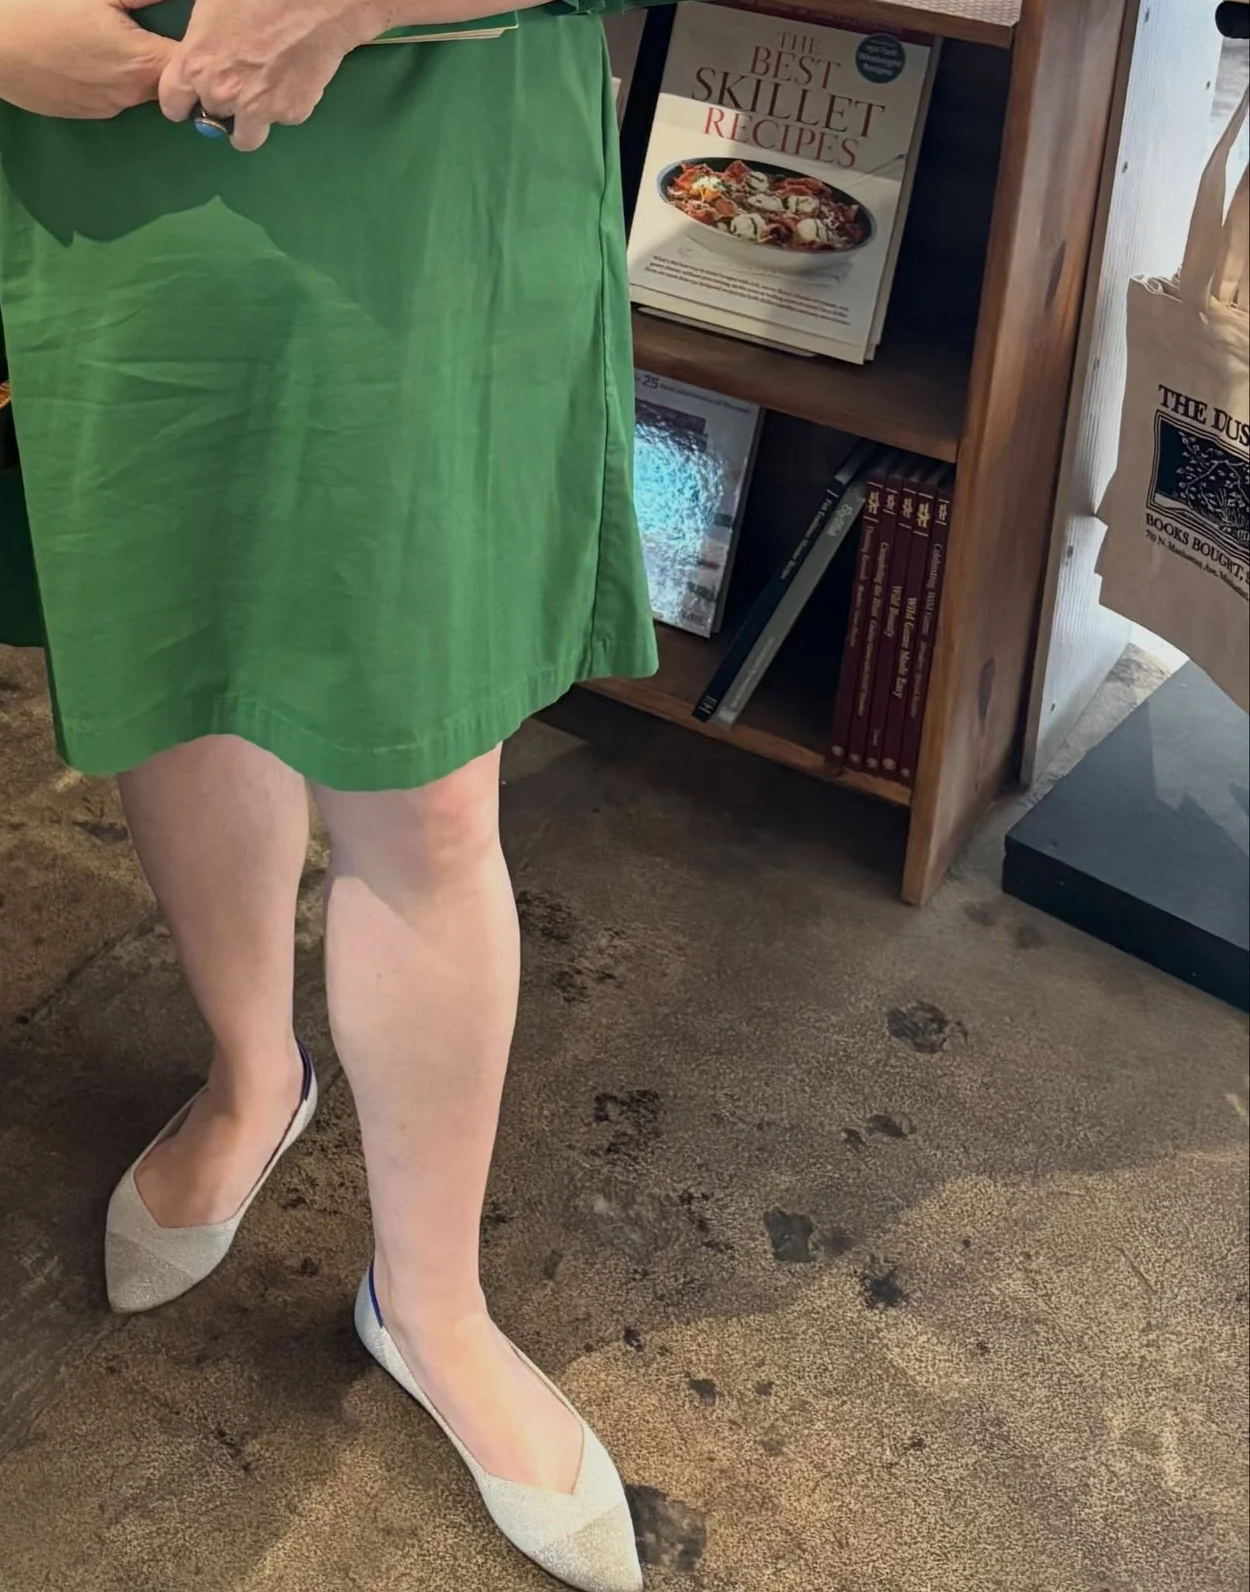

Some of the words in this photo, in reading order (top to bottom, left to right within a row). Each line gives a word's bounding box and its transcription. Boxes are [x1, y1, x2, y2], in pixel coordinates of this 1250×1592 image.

[750, 45, 842, 90] BEST
[777, 31, 822, 56] THE
[691, 66, 887, 138] SKILLET
[703, 107, 859, 169] RECIPES
[1146, 513, 1190, 547] BOOKS
[1192, 535, 1244, 583] BOUGHT,
